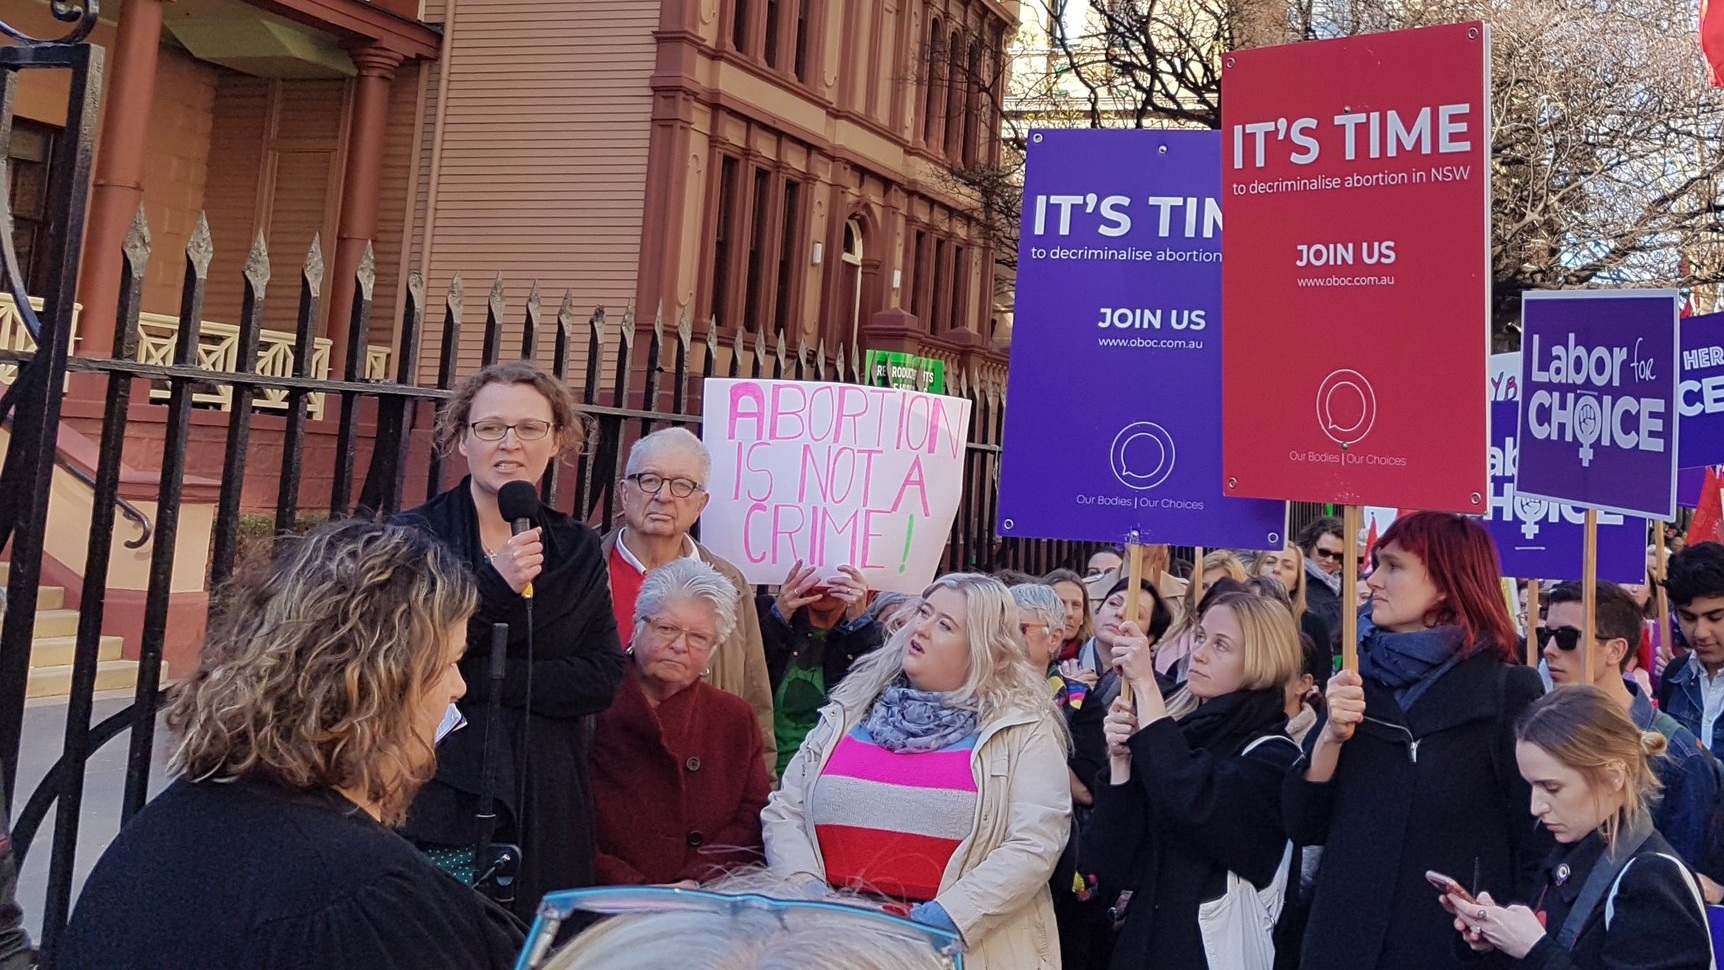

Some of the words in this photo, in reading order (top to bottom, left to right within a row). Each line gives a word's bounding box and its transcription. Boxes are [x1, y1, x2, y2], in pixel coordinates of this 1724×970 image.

[1233, 117, 1320, 170] IT’S
[1333, 103, 1471, 161] TIME
[1232, 181, 1247, 196] to
[1249, 174, 1341, 195] decriminalise
[1344, 169, 1408, 188] abortion
[1412, 167, 1426, 183] in
[1431, 165, 1471, 182] NSW
[1033, 192, 1132, 238] IT’S
[1030, 246, 1047, 260] to
[1049, 245, 1153, 262] decriminalise
[1155, 247, 1223, 263] abortion
[1295, 242, 1354, 267] JOIN
[1361, 240, 1396, 265] US
[1297, 274, 1395, 287] www.oboc.com.au
[1097, 307, 1162, 330] JOIN
[1169, 309, 1207, 331] US
[1097, 336, 1204, 349] www.oboc.com.au
[1531, 332, 1627, 387] Labor
[1682, 346, 1724, 371] HER
[727, 381, 965, 460] ABORTION
[1528, 389, 1665, 460] CHOICE
[1289, 450, 1307, 462] Our
[1308, 451, 1340, 463] Bodies
[1346, 453, 1365, 464] Our
[1366, 453, 1407, 467] Choices
[733, 441, 774, 503] IS
[797, 443, 884, 508] NOT
[890, 453, 931, 518] A
[1076, 494, 1096, 505] Our
[1098, 495, 1132, 507] Bodies
[1139, 497, 1159, 508] Our
[1161, 498, 1204, 511] Choices
[743, 501, 915, 574] CRIME!
